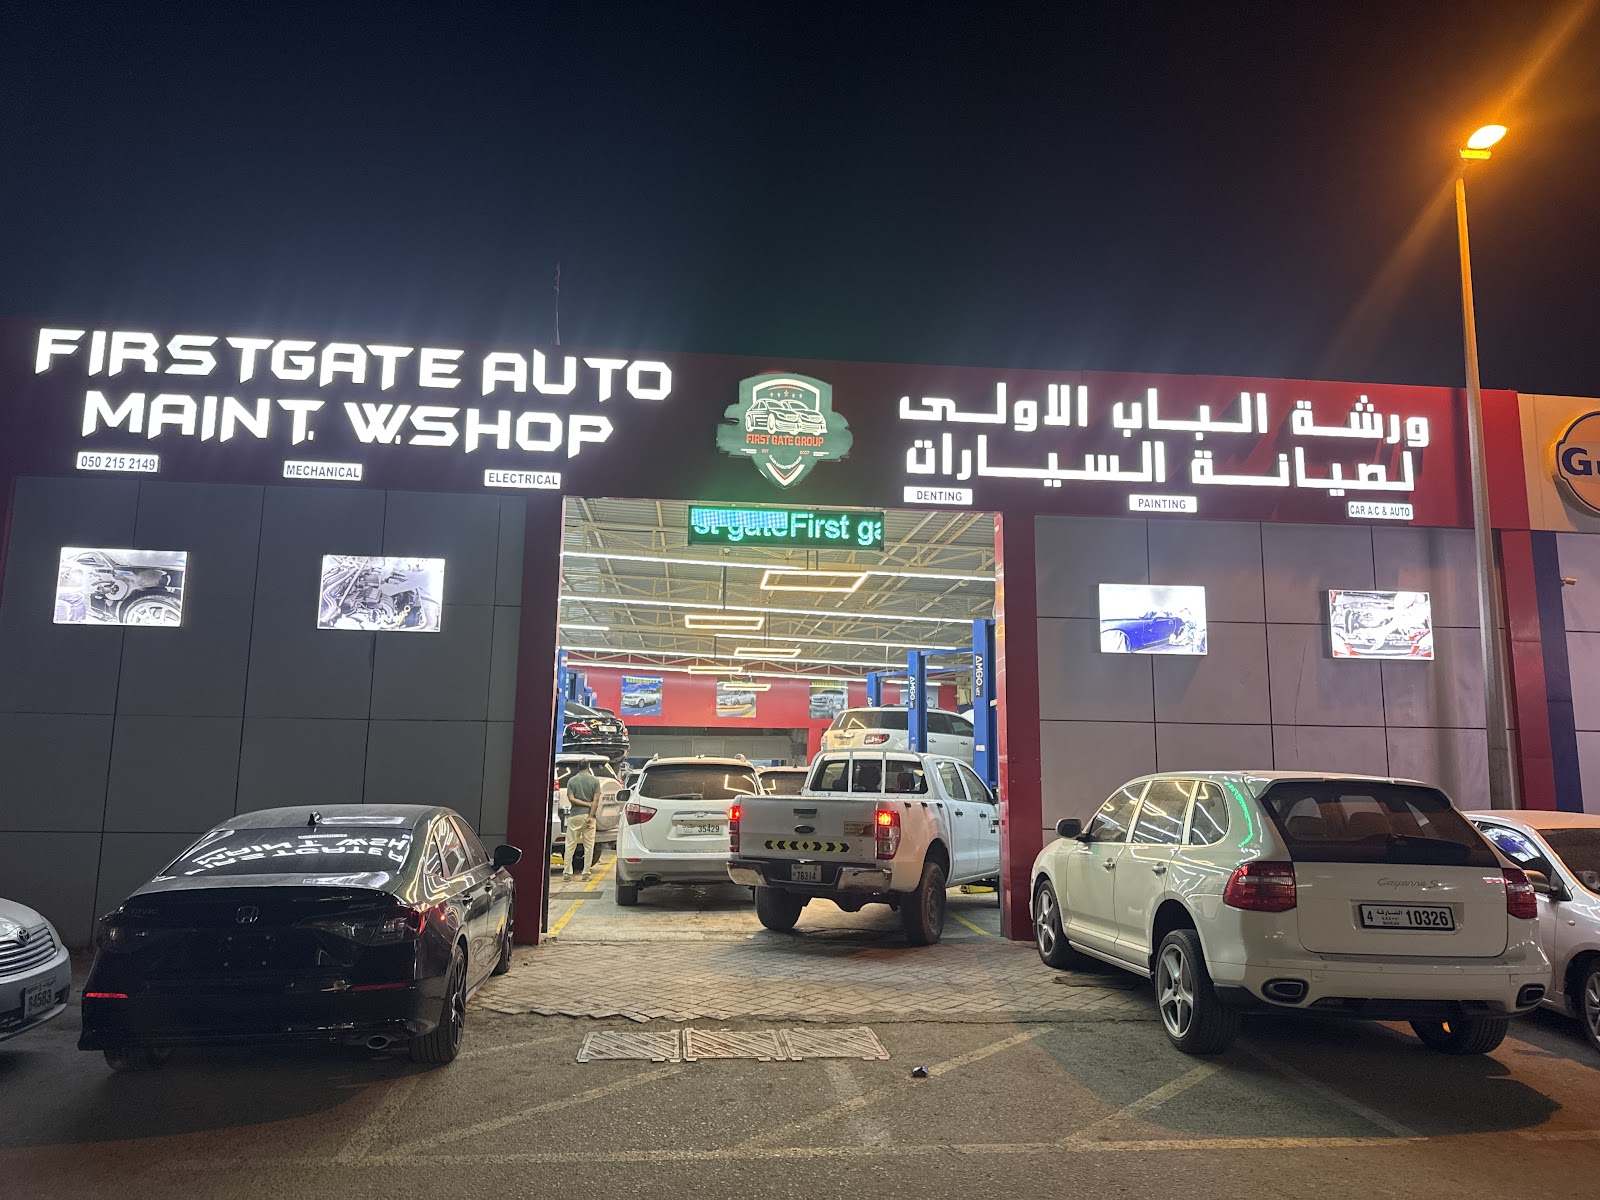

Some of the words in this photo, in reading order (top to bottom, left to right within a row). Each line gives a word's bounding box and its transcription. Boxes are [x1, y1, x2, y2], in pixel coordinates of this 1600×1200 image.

[36, 329, 464, 392] FIRSTGATE
[482, 349, 672, 402] AUTO
[900, 383, 1088, 432] الاولى
[1113, 388, 1268, 438] الباب
[82, 391, 325, 445] MAINT.
[344, 401, 614, 458] W.SHOP
[1292, 395, 1430, 448] ورشة
[746, 434, 770, 445] FIRST
[772, 435, 793, 446] GATE
[795, 436, 824, 447] GROUP
[81, 455, 101, 468] 050
[105, 456, 125, 469] 215
[128, 457, 156, 470] 2149
[907, 433, 1166, 488] السيارات
[1561, 447, 1600, 476] G
[286, 464, 360, 478] MECHANICAL
[488, 472, 558, 485] ELECTRICAL
[1191, 446, 1415, 497] لصيانة
[916, 490, 962, 502] DENTING
[1138, 498, 1186, 509] PAINTING
[1350, 505, 1366, 515] CAR
[1382, 506, 1388, 516] &
[1390, 507, 1410, 517] AUTO
[790, 512, 850, 539] First
[698, 824, 720, 833] 35429
[797, 871, 817, 881] 76314
[1367, 910, 1373, 922] 4
[1405, 909, 1449, 926] 10326
